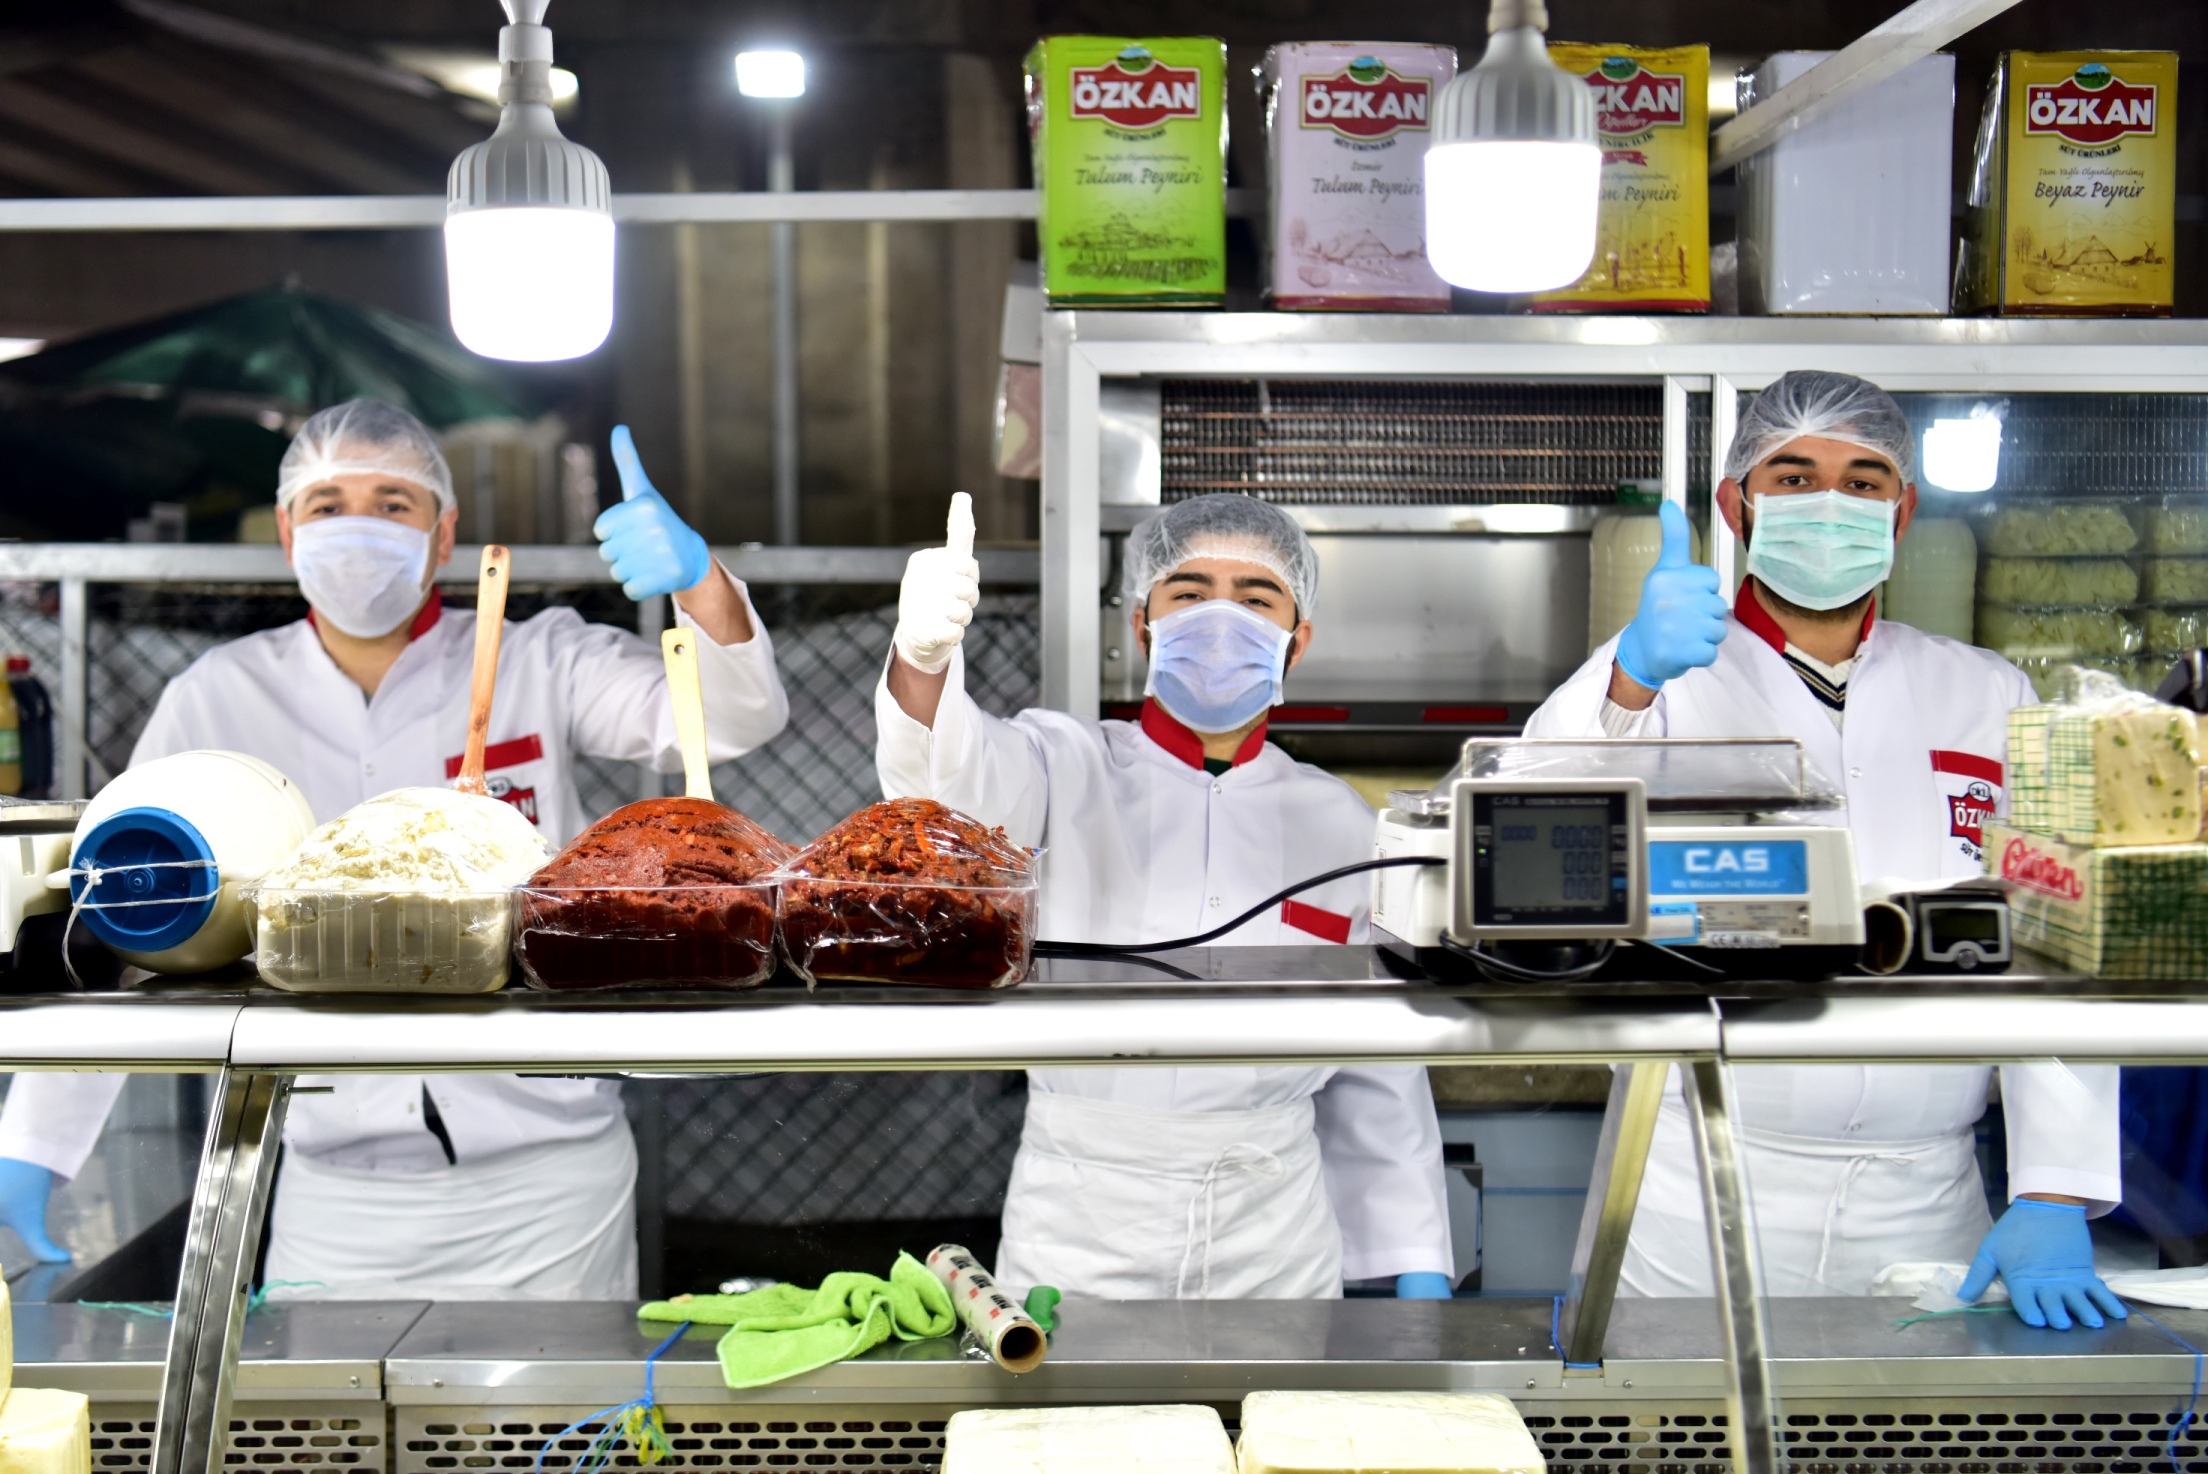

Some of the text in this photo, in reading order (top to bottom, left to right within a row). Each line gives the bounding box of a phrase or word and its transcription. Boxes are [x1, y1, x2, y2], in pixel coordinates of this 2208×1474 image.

[1075, 75, 1196, 109] ÖZKAN
[1307, 84, 1428, 120] ÖZKAN
[1593, 85, 1680, 112] ZKAN
[2030, 92, 2152, 125] ÖZKAN
[2059, 143, 2122, 158] SÜT ÜRÜNLERİ
[1074, 165, 1203, 195] Tulum Peyniri
[1311, 173, 1424, 205] Tulum Peyniri
[2034, 180, 2145, 209] Beyaz Peynir
[1624, 183, 1681, 211] Peyniri
[1685, 848, 1770, 873] CAS
